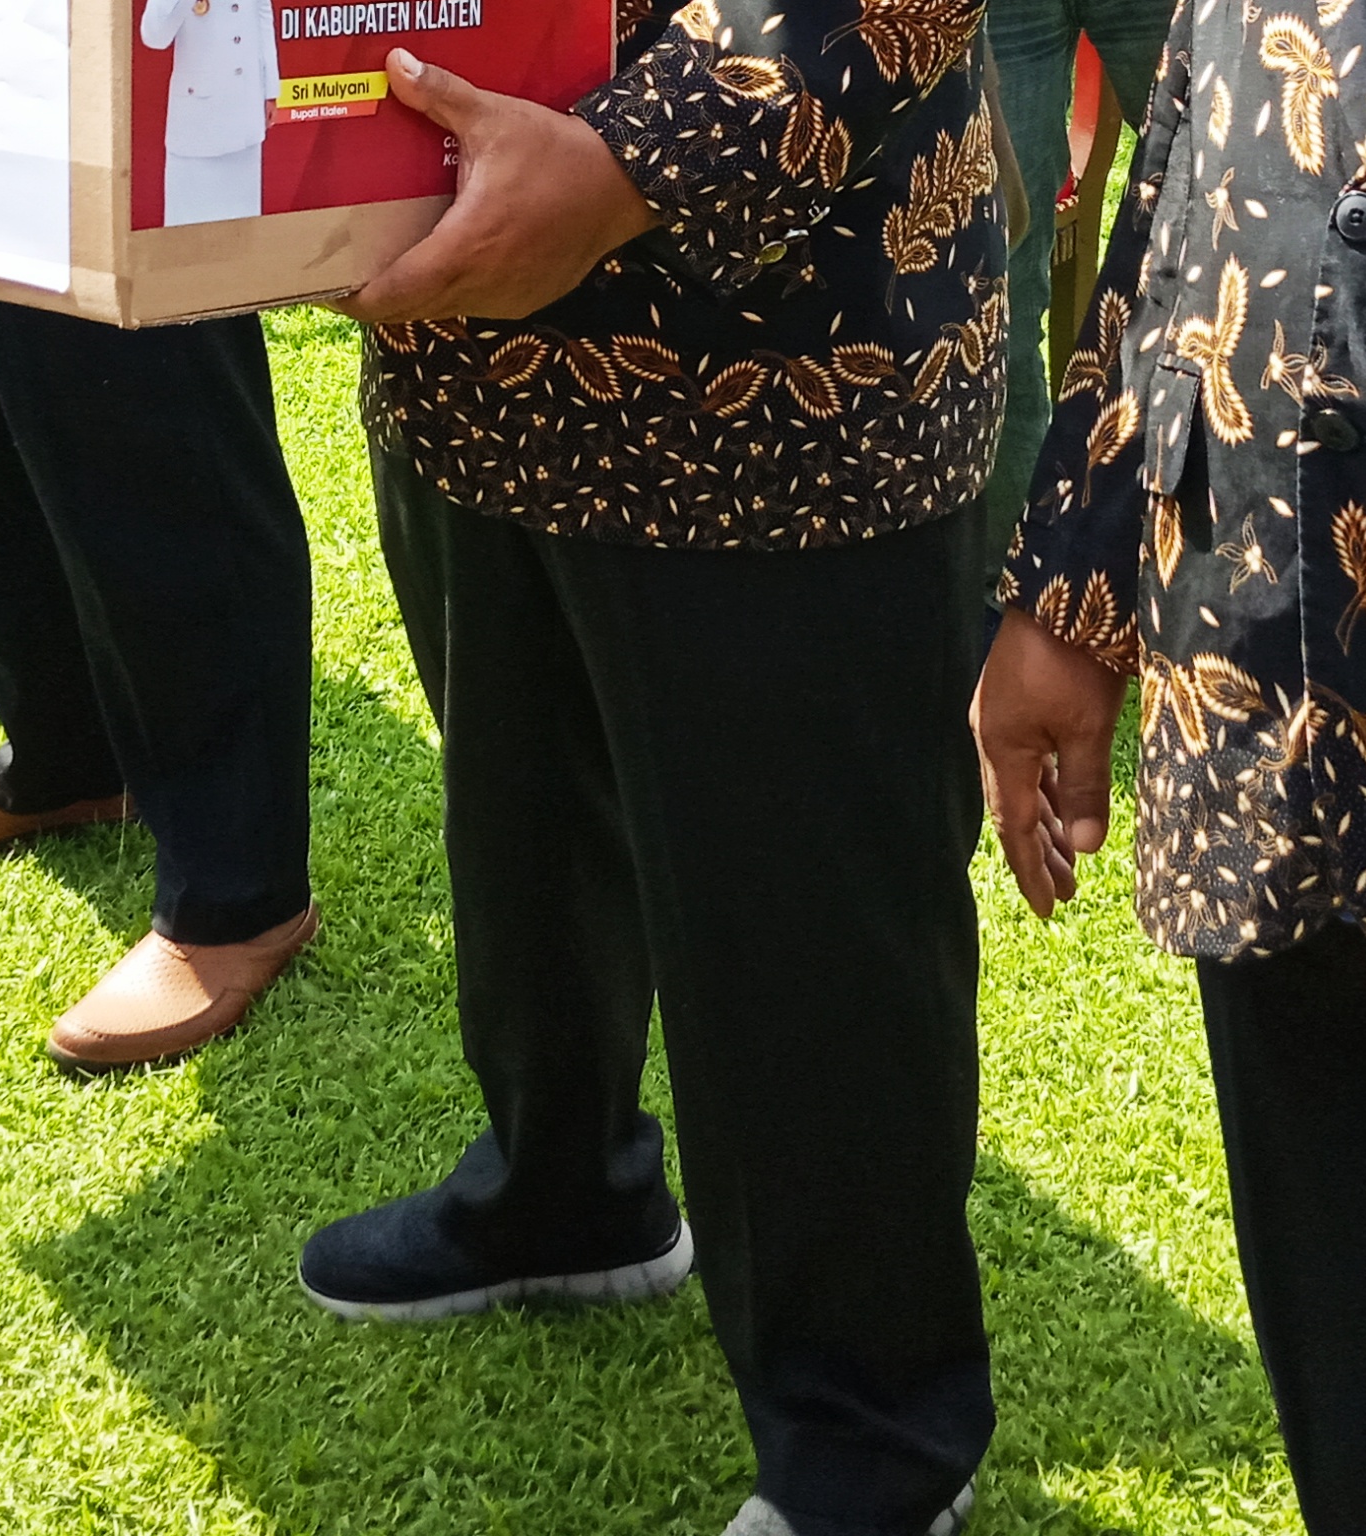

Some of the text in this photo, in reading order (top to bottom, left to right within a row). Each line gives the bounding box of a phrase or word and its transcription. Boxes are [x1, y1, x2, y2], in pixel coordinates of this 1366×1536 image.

[281, 9, 300, 40] DI
[305, 1, 410, 38] KABUPATEN
[292, 79, 370, 100] Sri Mulyani
[290, 106, 348, 120] Bupati Klaten
